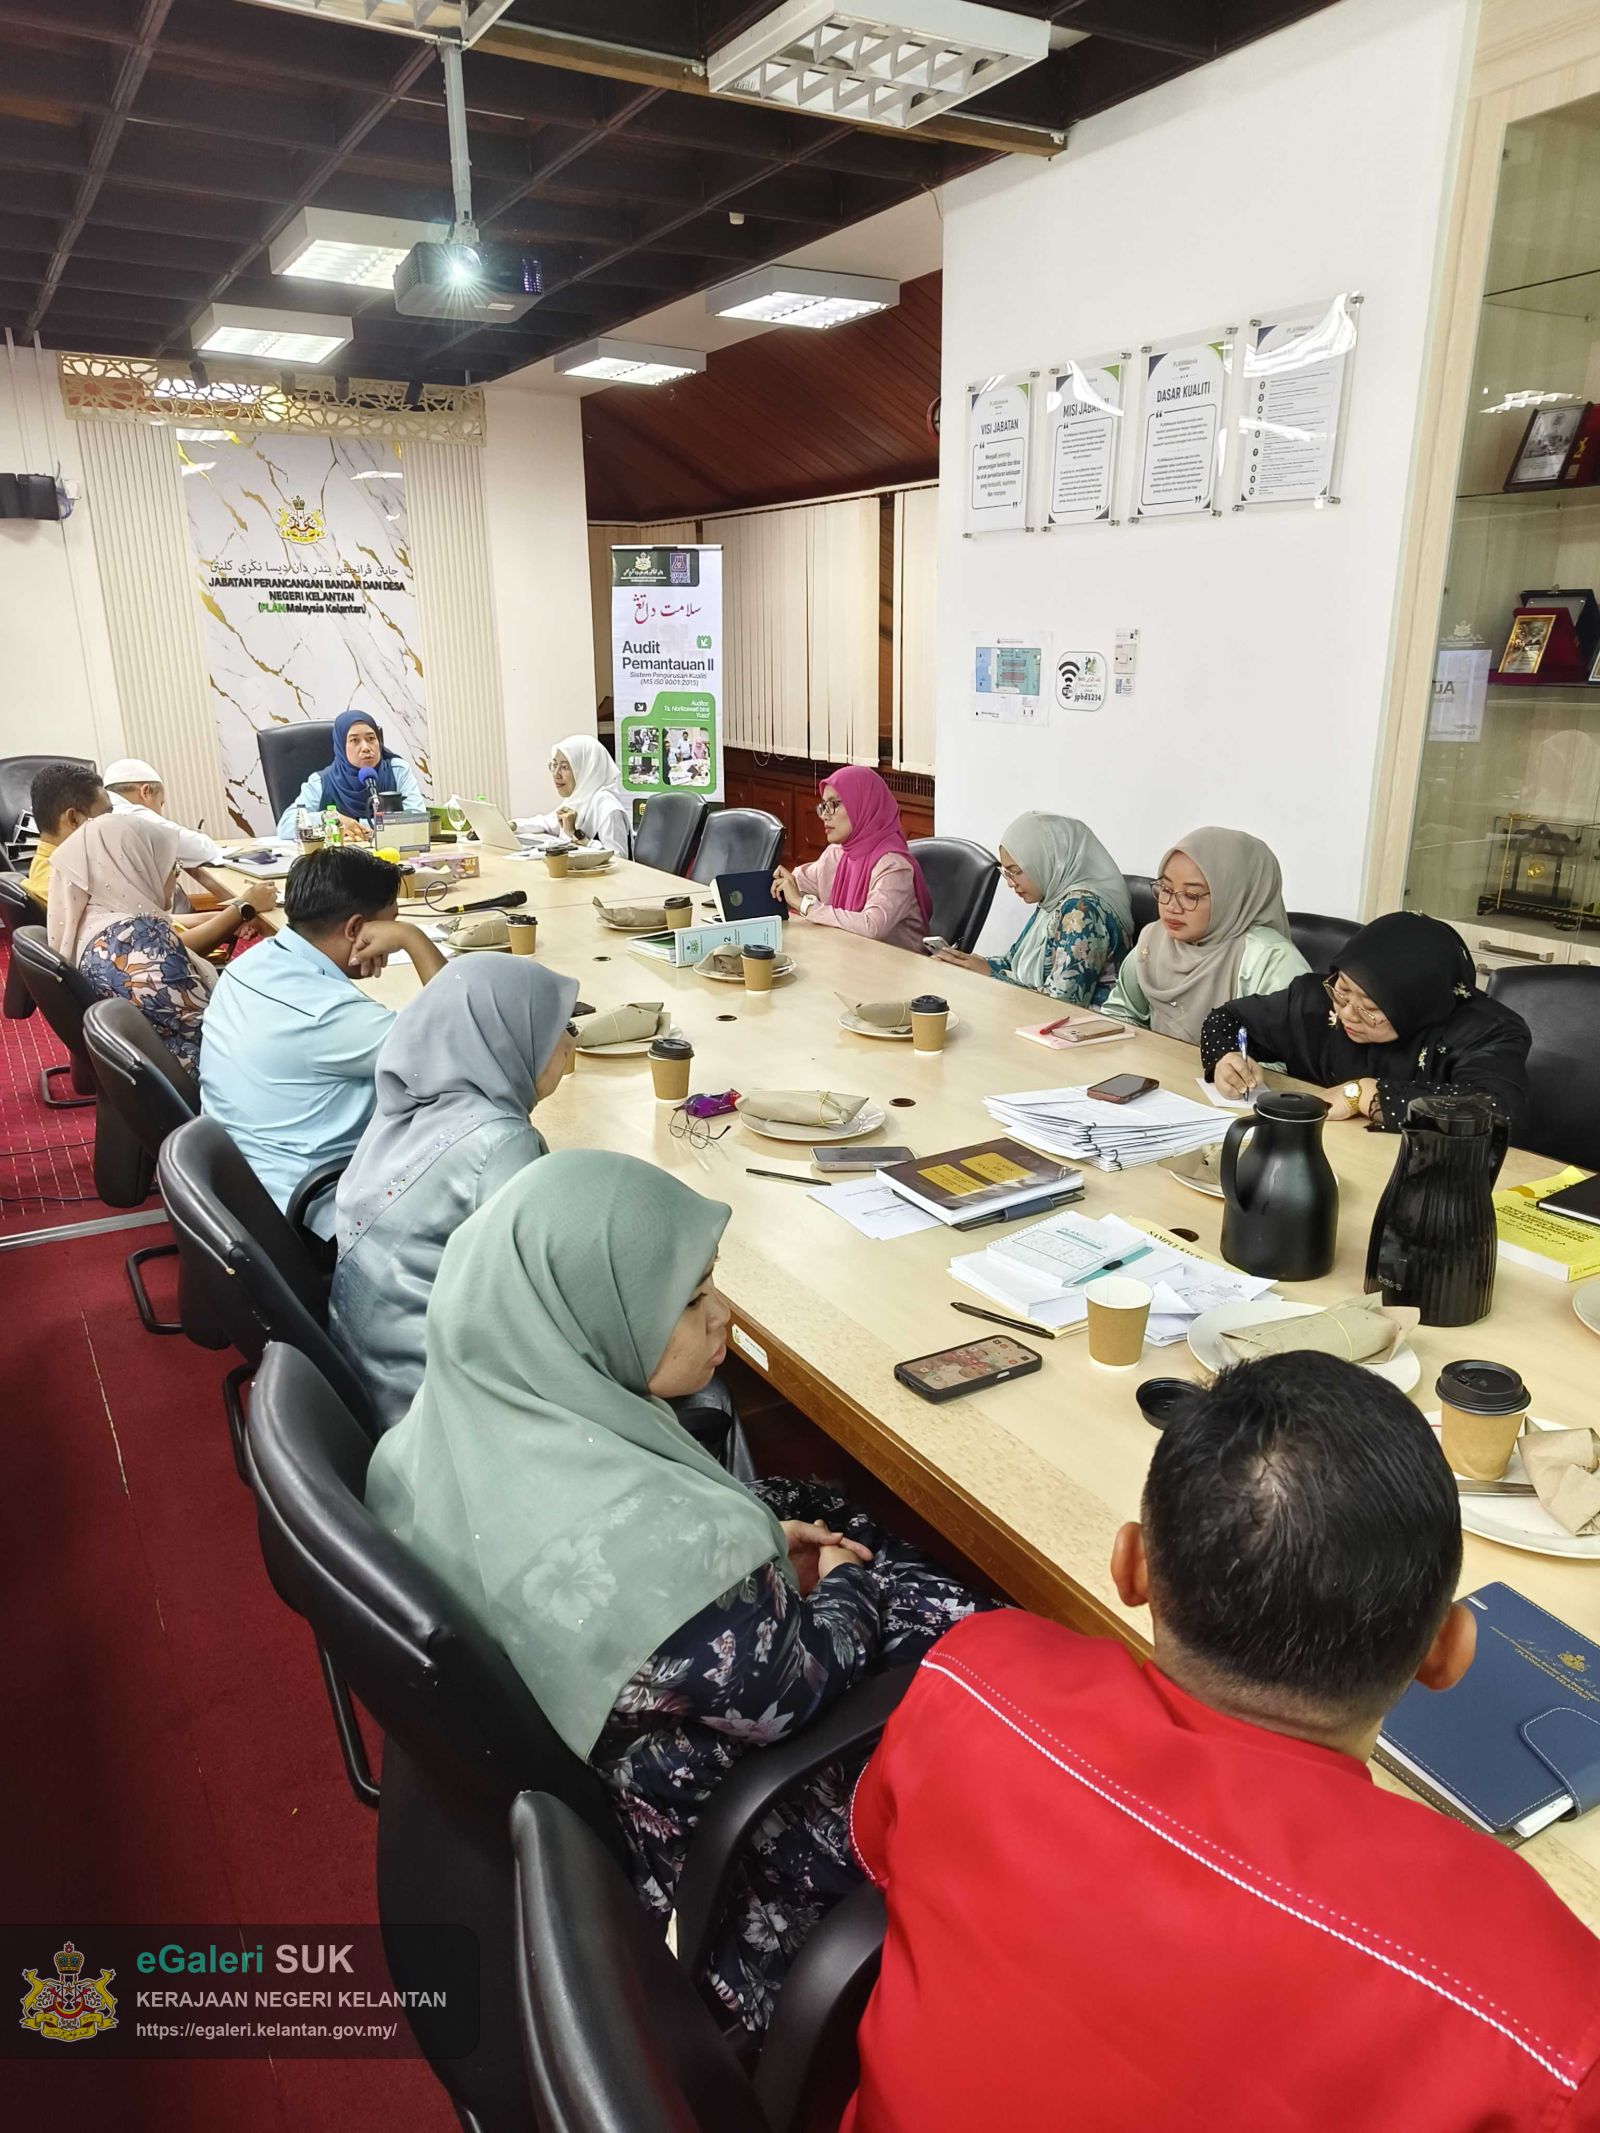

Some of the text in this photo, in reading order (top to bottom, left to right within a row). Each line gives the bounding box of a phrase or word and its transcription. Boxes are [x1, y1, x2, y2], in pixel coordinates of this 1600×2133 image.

[1157, 381, 1211, 403] DASAR KUALITI
[1063, 403, 1078, 418] MISI
[980, 418, 1019, 435] VISI JABATAN
[208, 577, 406, 592] JABATAN PERANCANGAN BANDAR DAN DESA
[269, 591, 355, 602] NEGERI KELANTAN
[622, 640, 661, 654] Audit
[622, 657, 705, 671] Pemantauan
